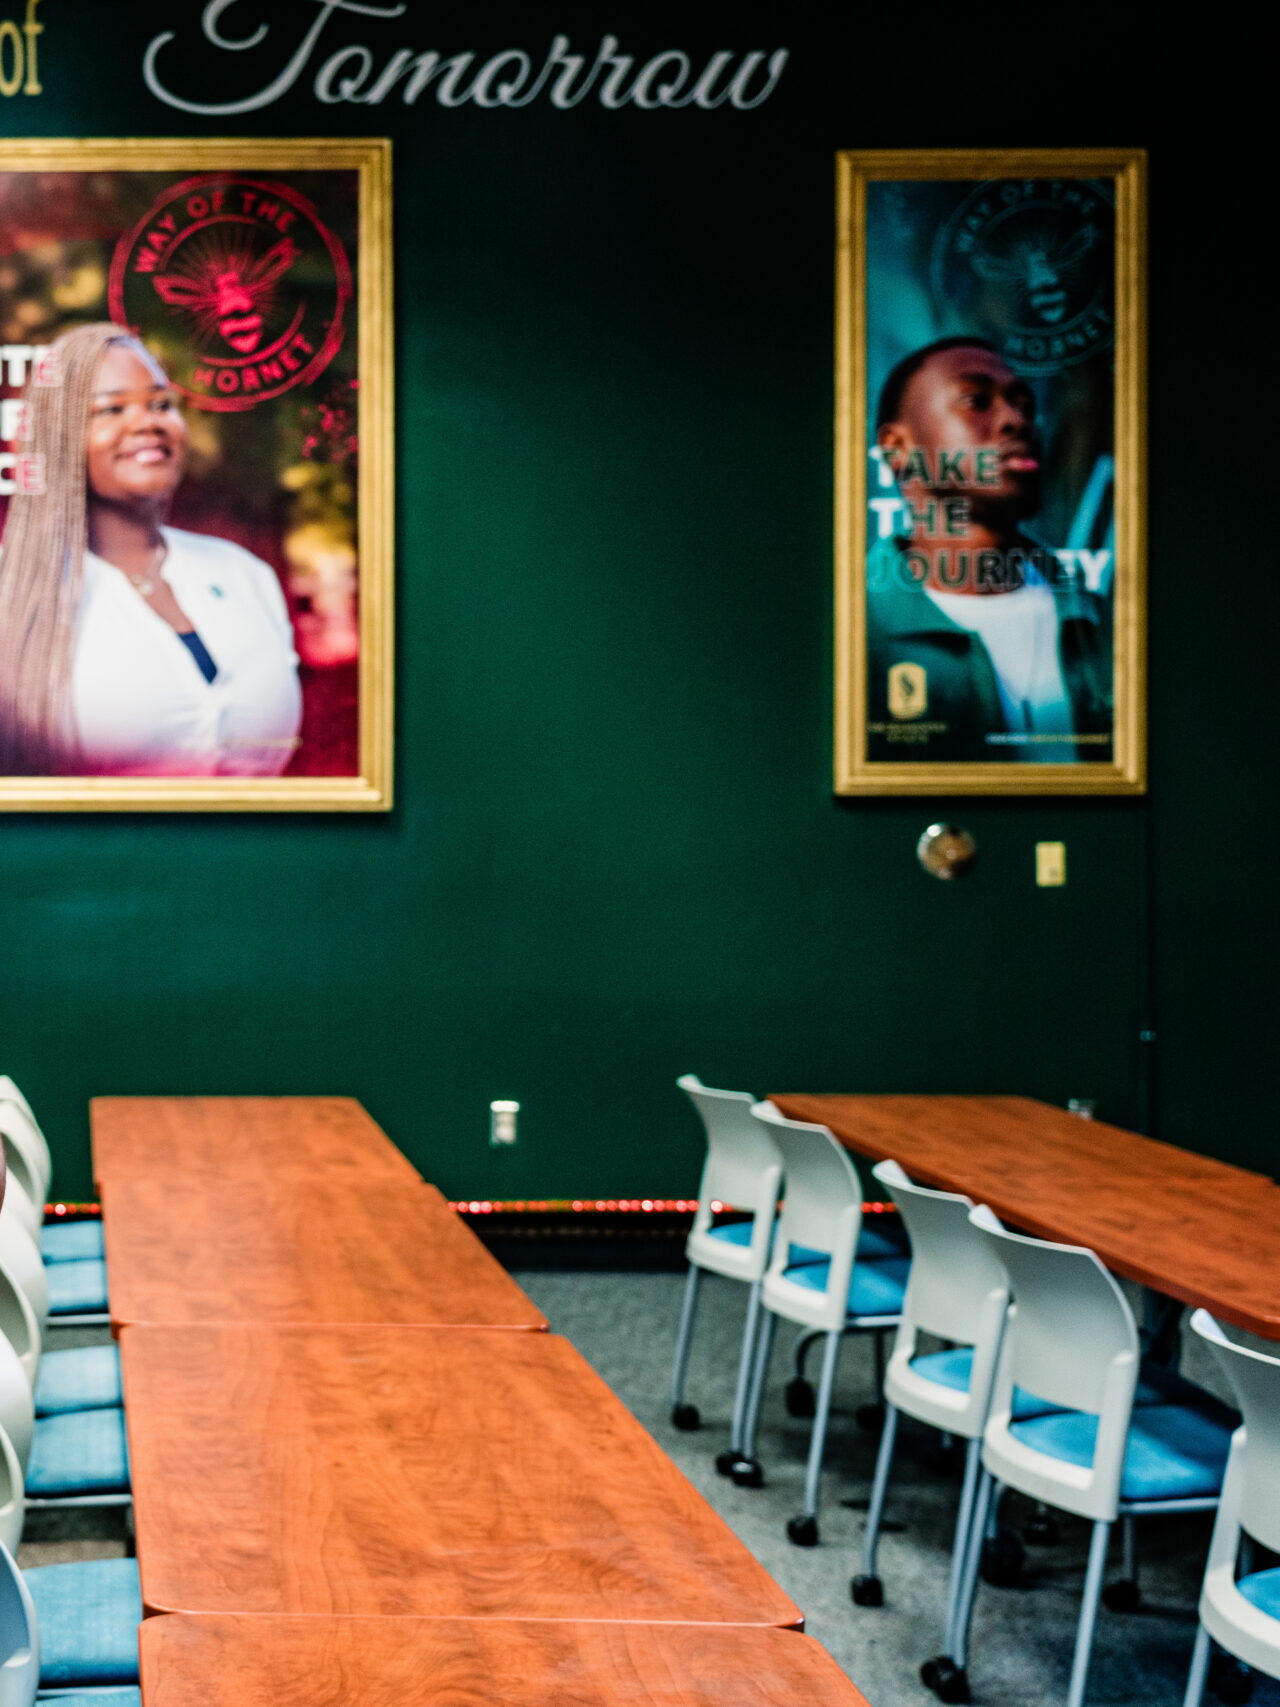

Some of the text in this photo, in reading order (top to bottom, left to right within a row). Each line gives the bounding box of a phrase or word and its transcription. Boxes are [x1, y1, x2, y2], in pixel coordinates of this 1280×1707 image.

[143, 0, 789, 115] Tomorrow
[134, 190, 297, 273] WAY OF THE
[192, 333, 314, 393] HORNET
[869, 445, 1002, 488] TAKE
[869, 497, 971, 540] THE
[868, 548, 1112, 593] JOURNEY
